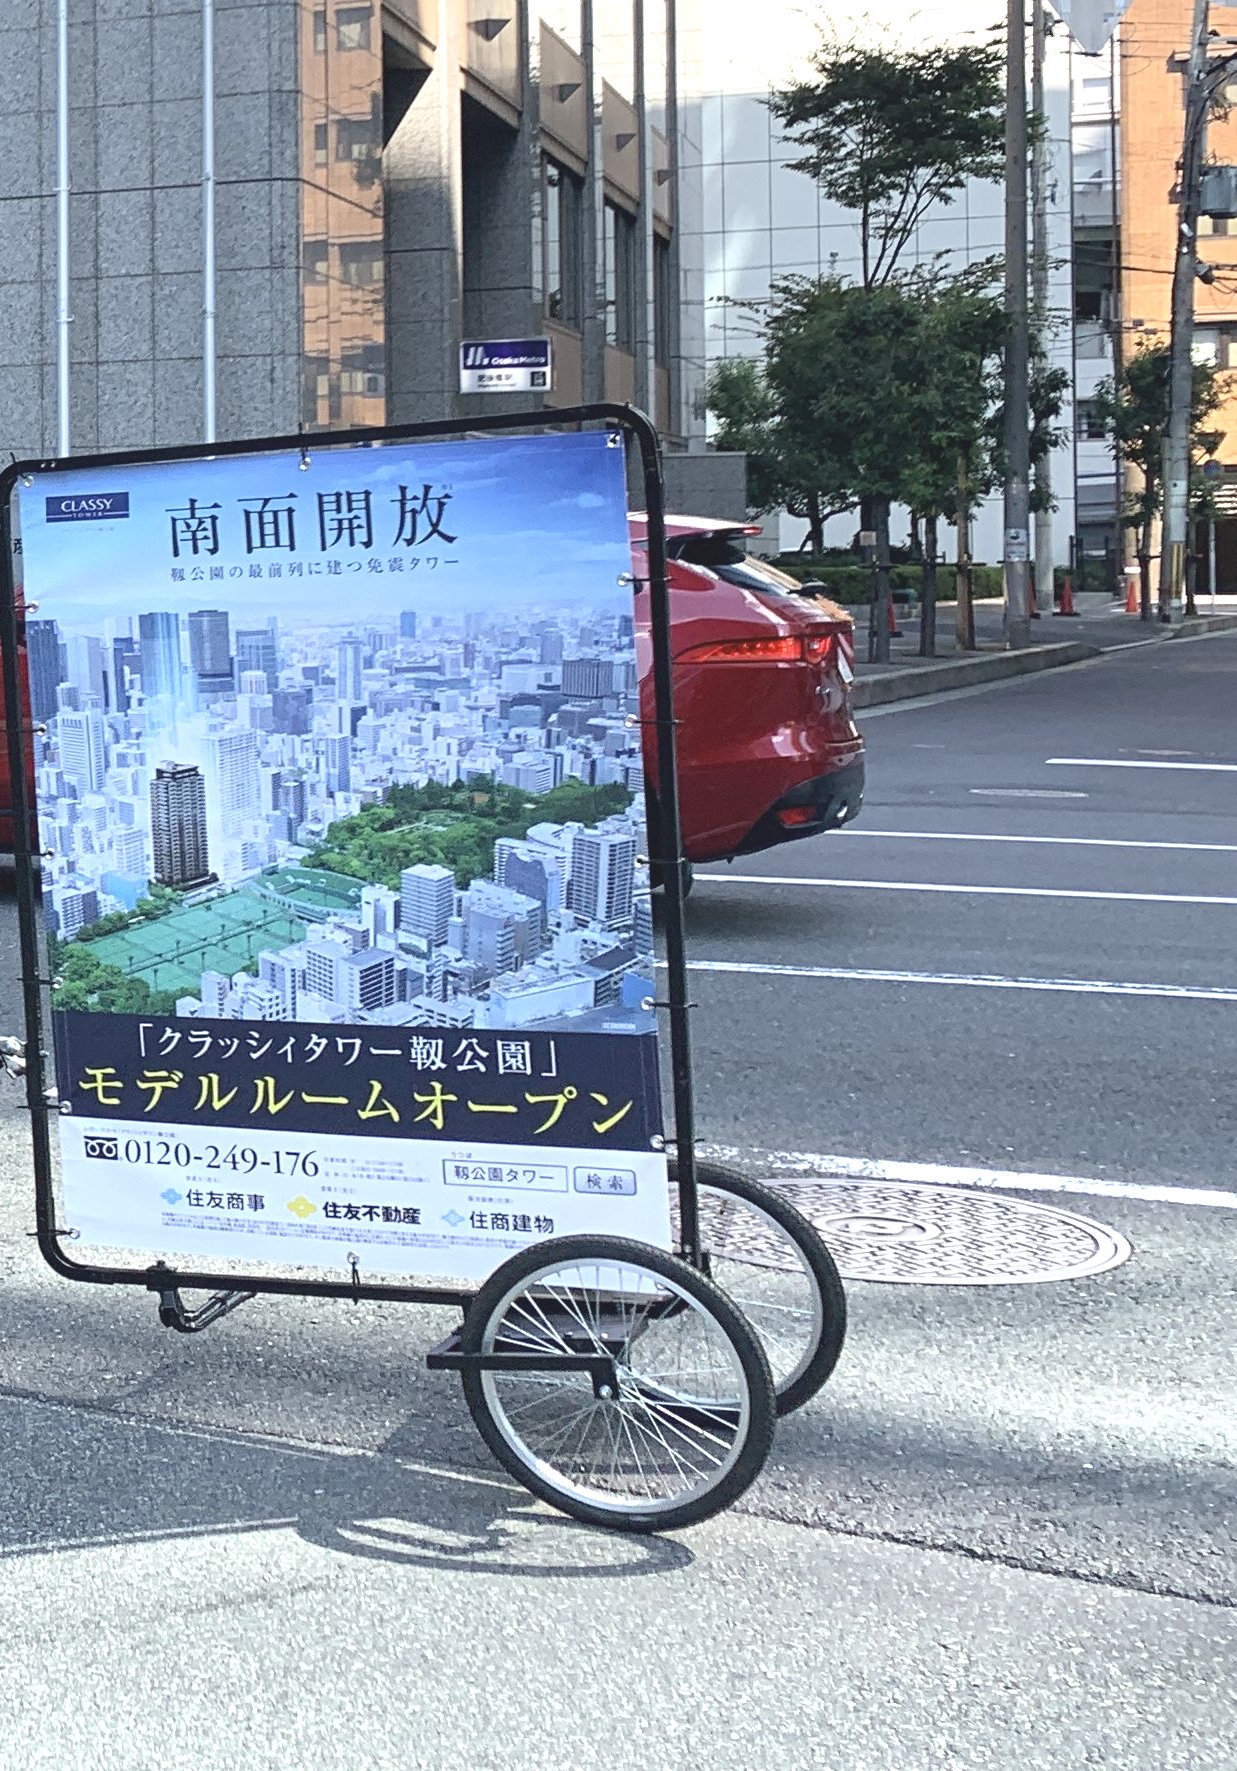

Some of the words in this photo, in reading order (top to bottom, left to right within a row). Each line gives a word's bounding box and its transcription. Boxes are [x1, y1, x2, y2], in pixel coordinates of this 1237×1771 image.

[61, 498, 113, 512] CLASSY
[165, 484, 459, 558] 南面開放
[78, 1066, 634, 1135] モデルルームオープン
[124, 1138, 320, 1178] 0120-249-176
[186, 1188, 266, 1212] 住友商事
[322, 1201, 422, 1226] 住友不動産
[469, 1211, 555, 1234] 住商建物
